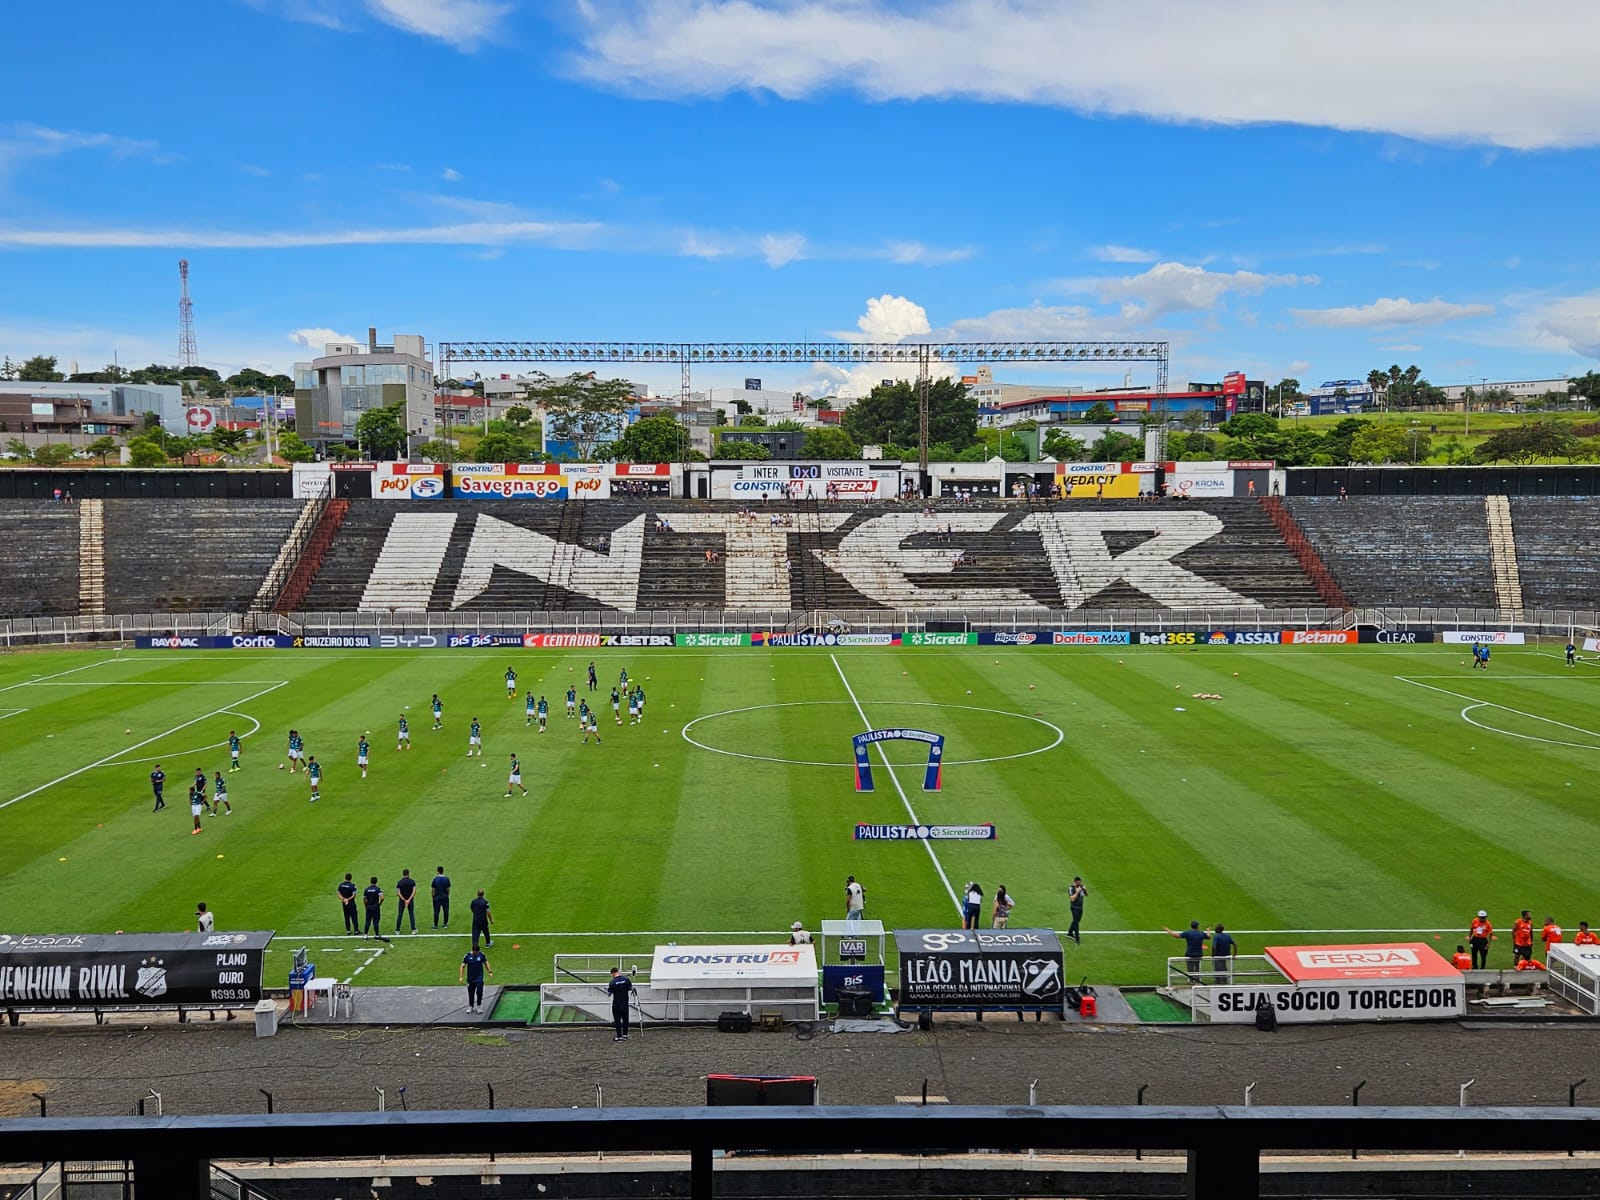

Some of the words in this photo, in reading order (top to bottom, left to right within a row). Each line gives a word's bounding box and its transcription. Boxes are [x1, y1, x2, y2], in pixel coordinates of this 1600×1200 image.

[753, 467, 779, 478] INTER
[826, 467, 864, 477] VISITANTE
[381, 478, 409, 493] poty
[461, 477, 559, 496] Savegnago
[575, 479, 602, 494] poty
[1195, 480, 1225, 488] KRONA
[357, 512, 1262, 611] INTER
[151, 638, 199, 647] RAYOVAC
[232, 636, 275, 648] Corfio
[304, 638, 342, 647] CRUZEIRO
[343, 638, 354, 647] DO
[355, 638, 370, 647] SUL
[380, 635, 437, 647] BYD
[543, 635, 599, 647] CENTAURO
[698, 634, 742, 646] Sicredi
[924, 633, 968, 645] Sicredi
[1055, 634, 1098, 643] Dorflex
[1100, 634, 1126, 643] MAX
[1139, 632, 1196, 645] bet365
[1293, 631, 1347, 644] Betano
[842, 943, 864, 951] VAR
[216, 953, 247, 966] PLANO
[907, 956, 951, 984] LEÃO
[960, 959, 1021, 983] MANIA
[78, 964, 130, 999] RIVAL
[218, 971, 244, 984] OURO
[1348, 989, 1457, 1009] TORCEDOR
